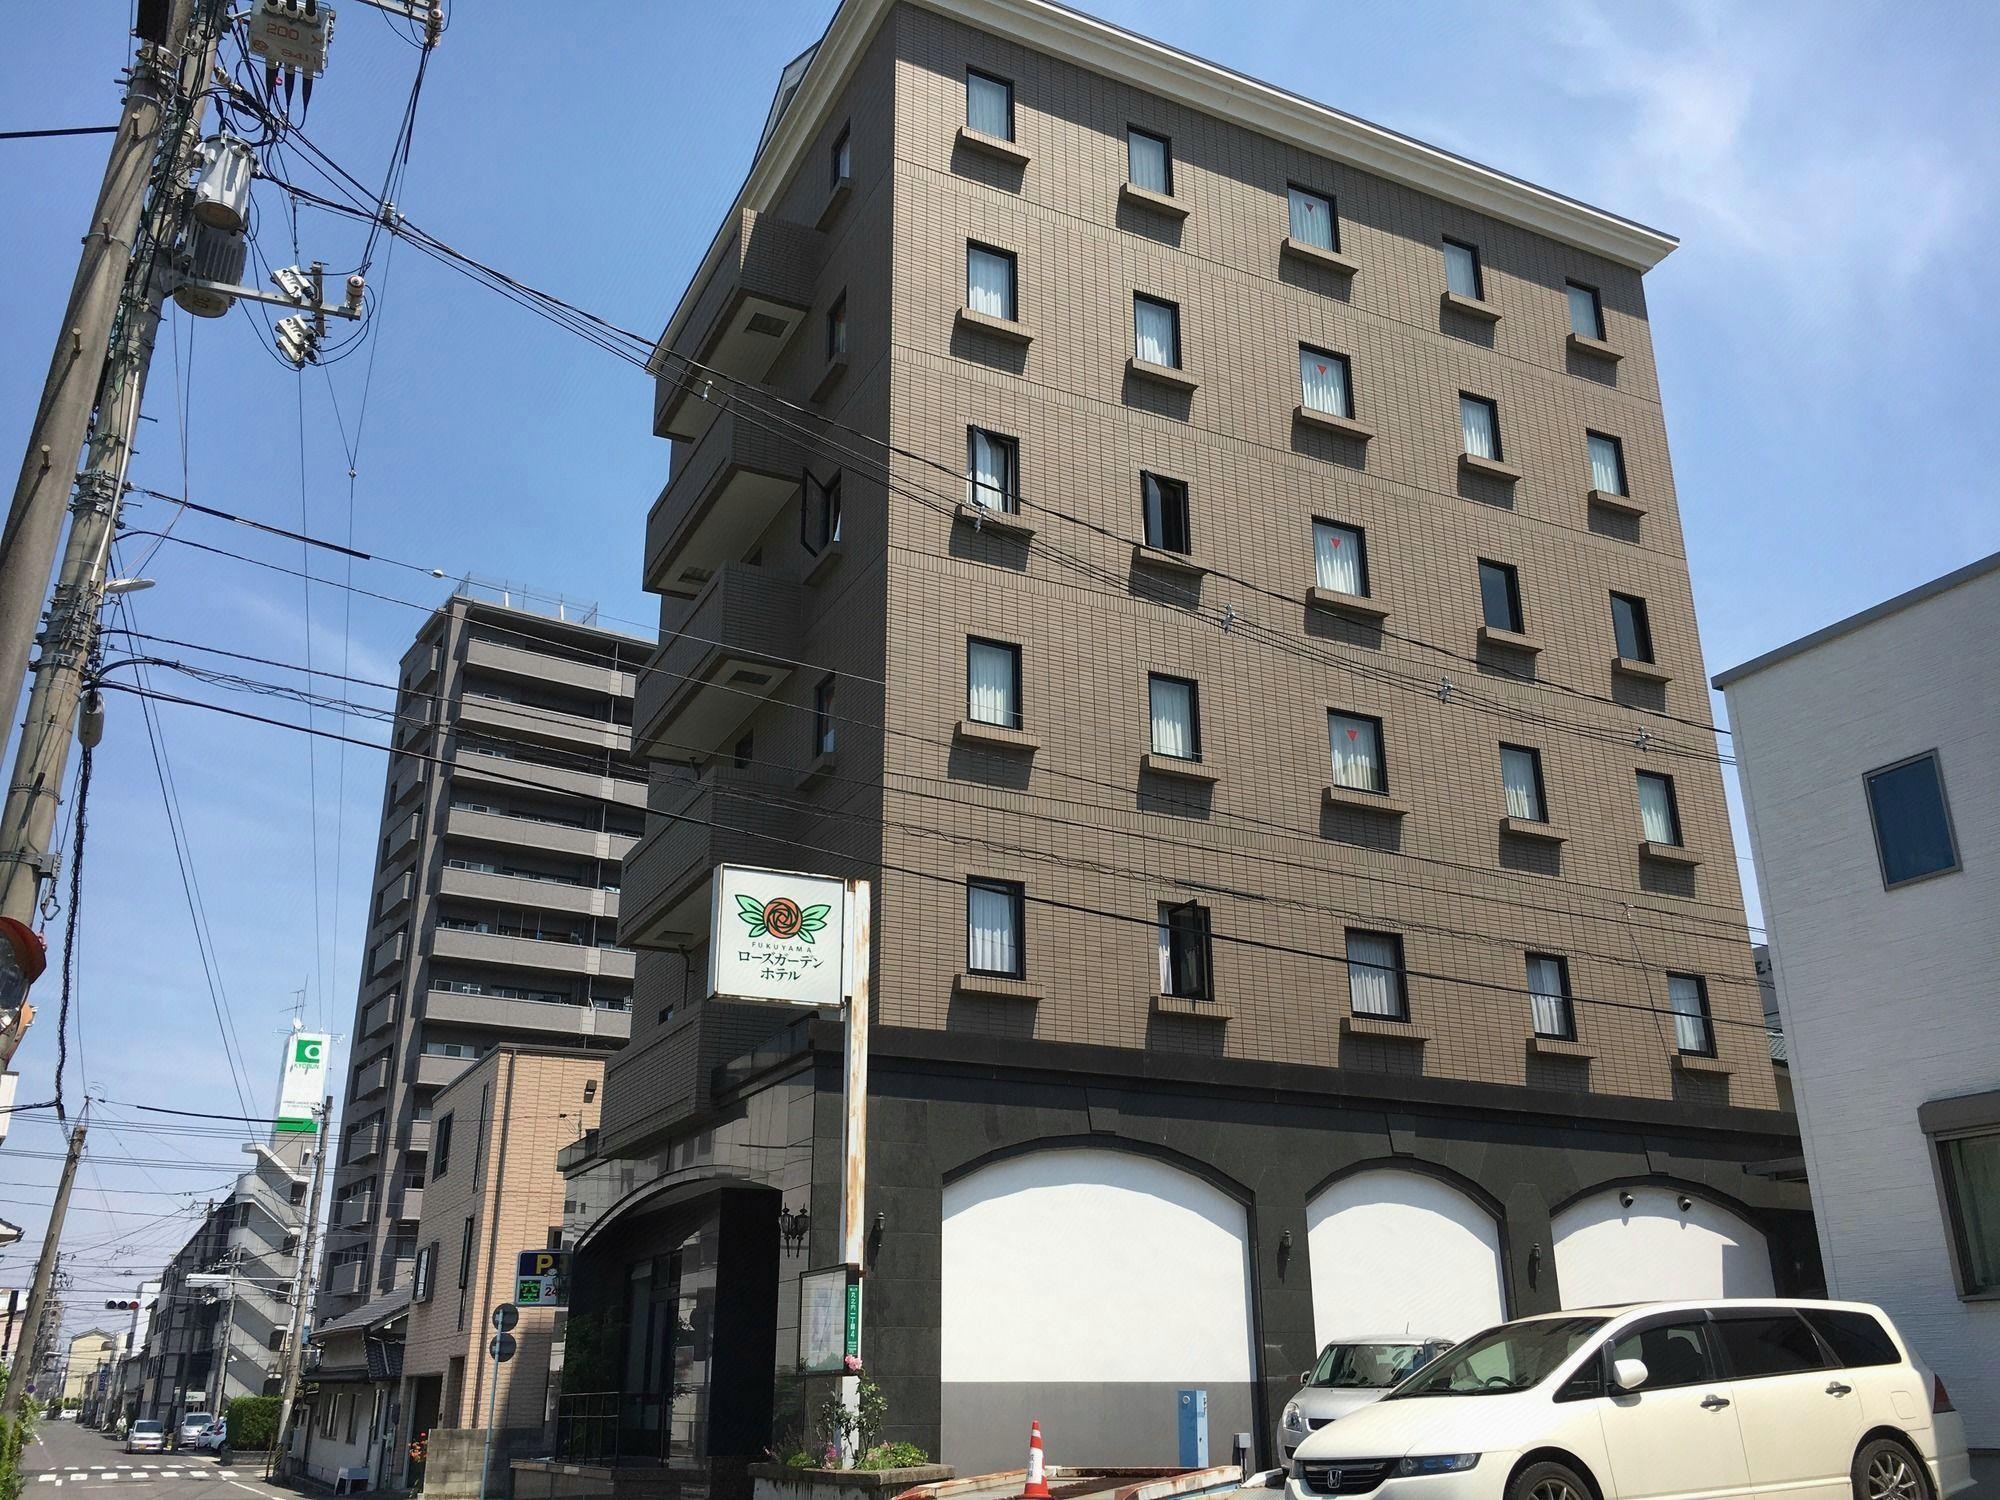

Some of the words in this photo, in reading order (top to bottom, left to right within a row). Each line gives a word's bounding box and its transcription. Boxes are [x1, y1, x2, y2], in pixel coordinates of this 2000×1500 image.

[266, 23, 300, 41] 200
[751, 941, 812, 953] FUKUYAMA
[738, 951, 824, 968] ローズガーデン
[760, 967, 802, 982] ホテル
[535, 1254, 554, 1275] P
